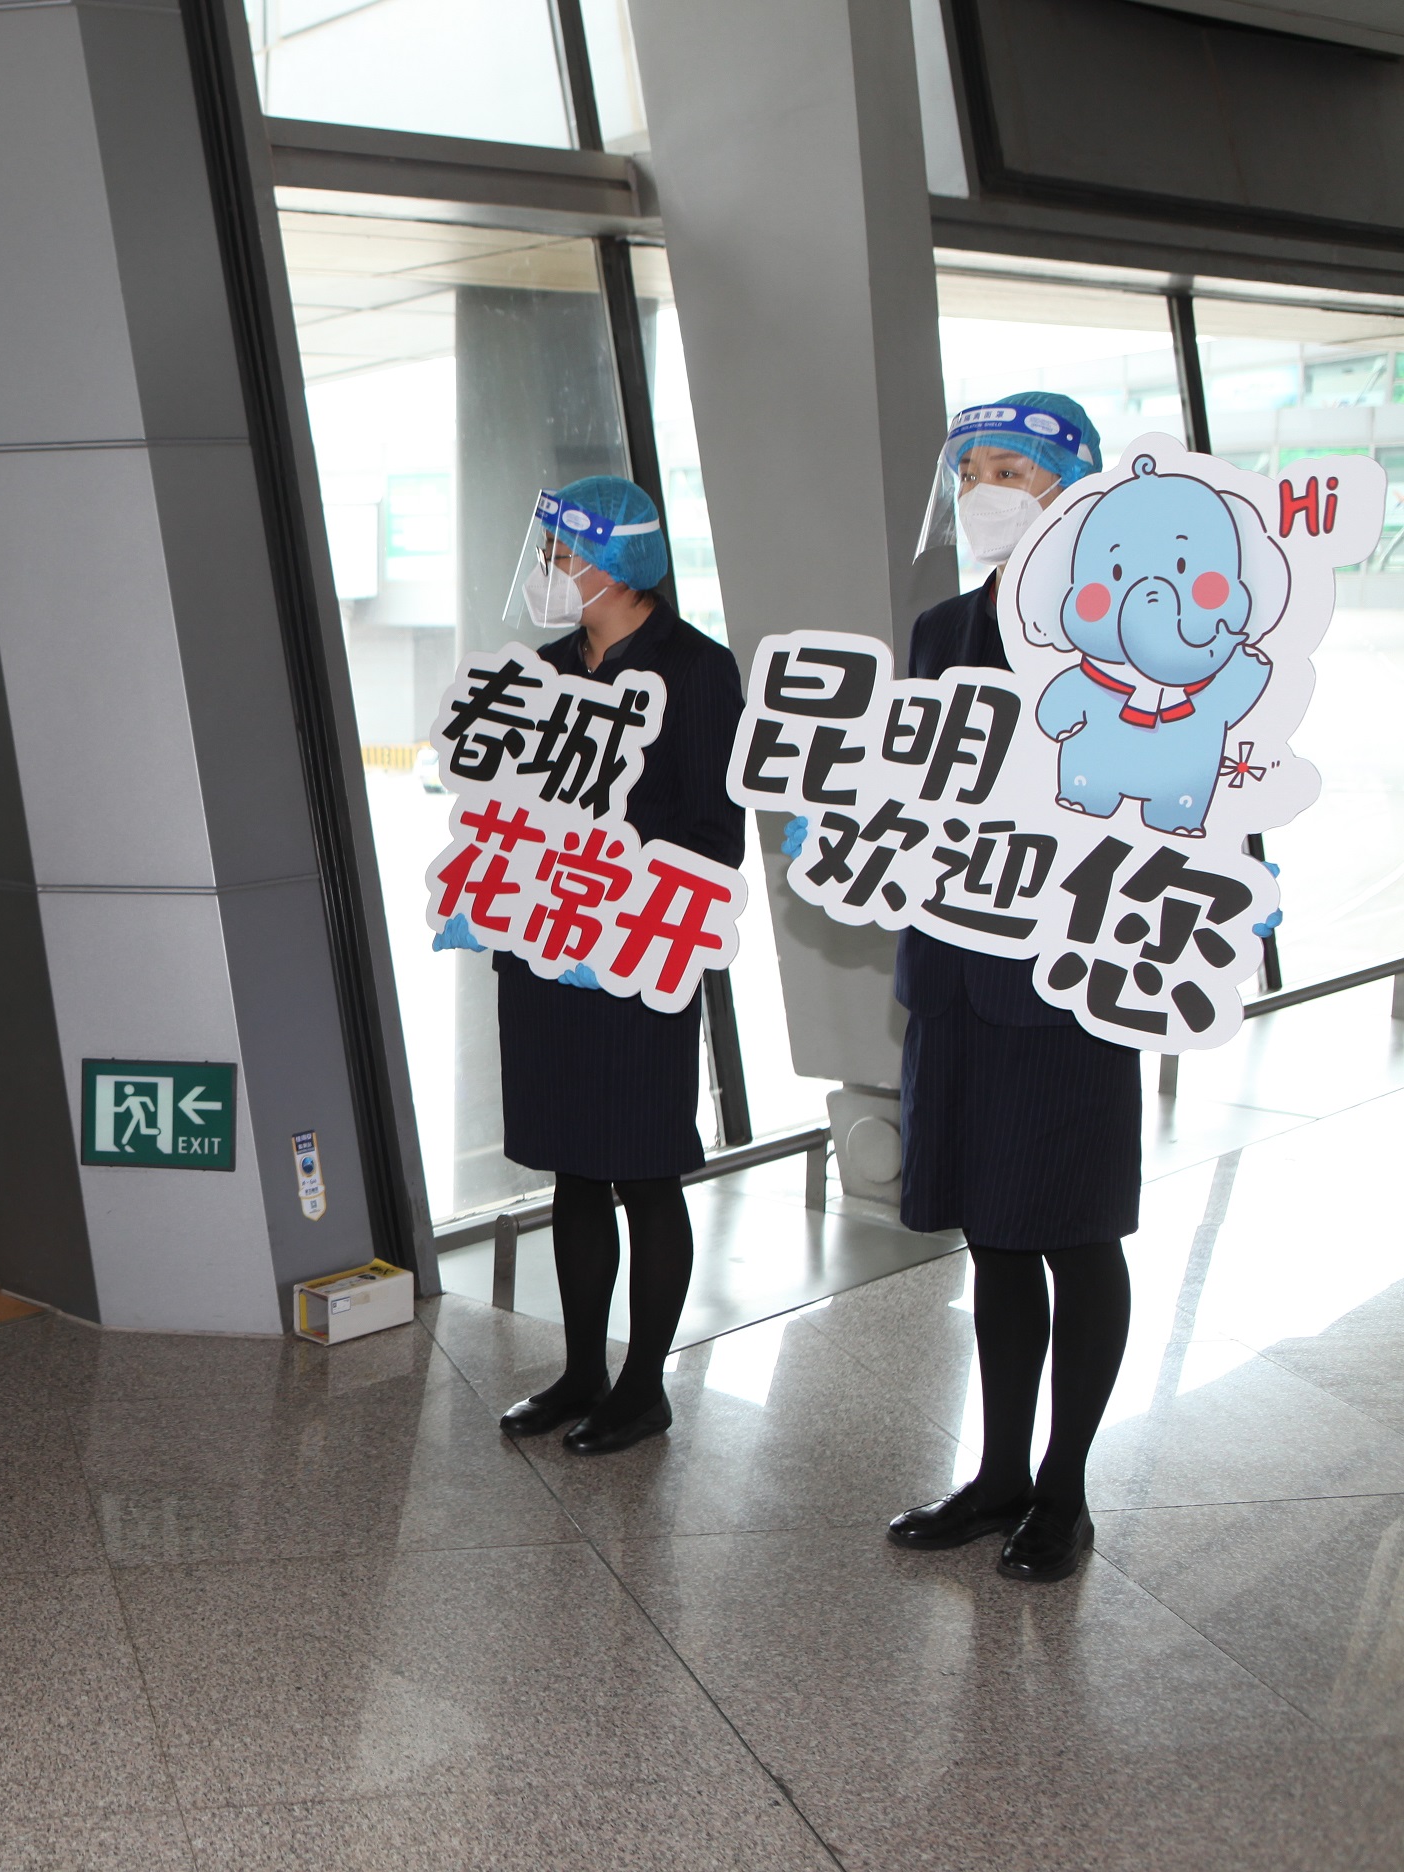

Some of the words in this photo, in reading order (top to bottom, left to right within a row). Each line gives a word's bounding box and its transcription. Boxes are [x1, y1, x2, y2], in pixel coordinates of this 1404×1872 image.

[1278, 475, 1340, 540] Hi
[441, 659, 650, 820] 春城
[742, 647, 1022, 806] 昆明
[437, 800, 732, 994] 花常开
[805, 799, 1253, 1036] 欢迎您
[177, 1136, 222, 1155] EXIT
